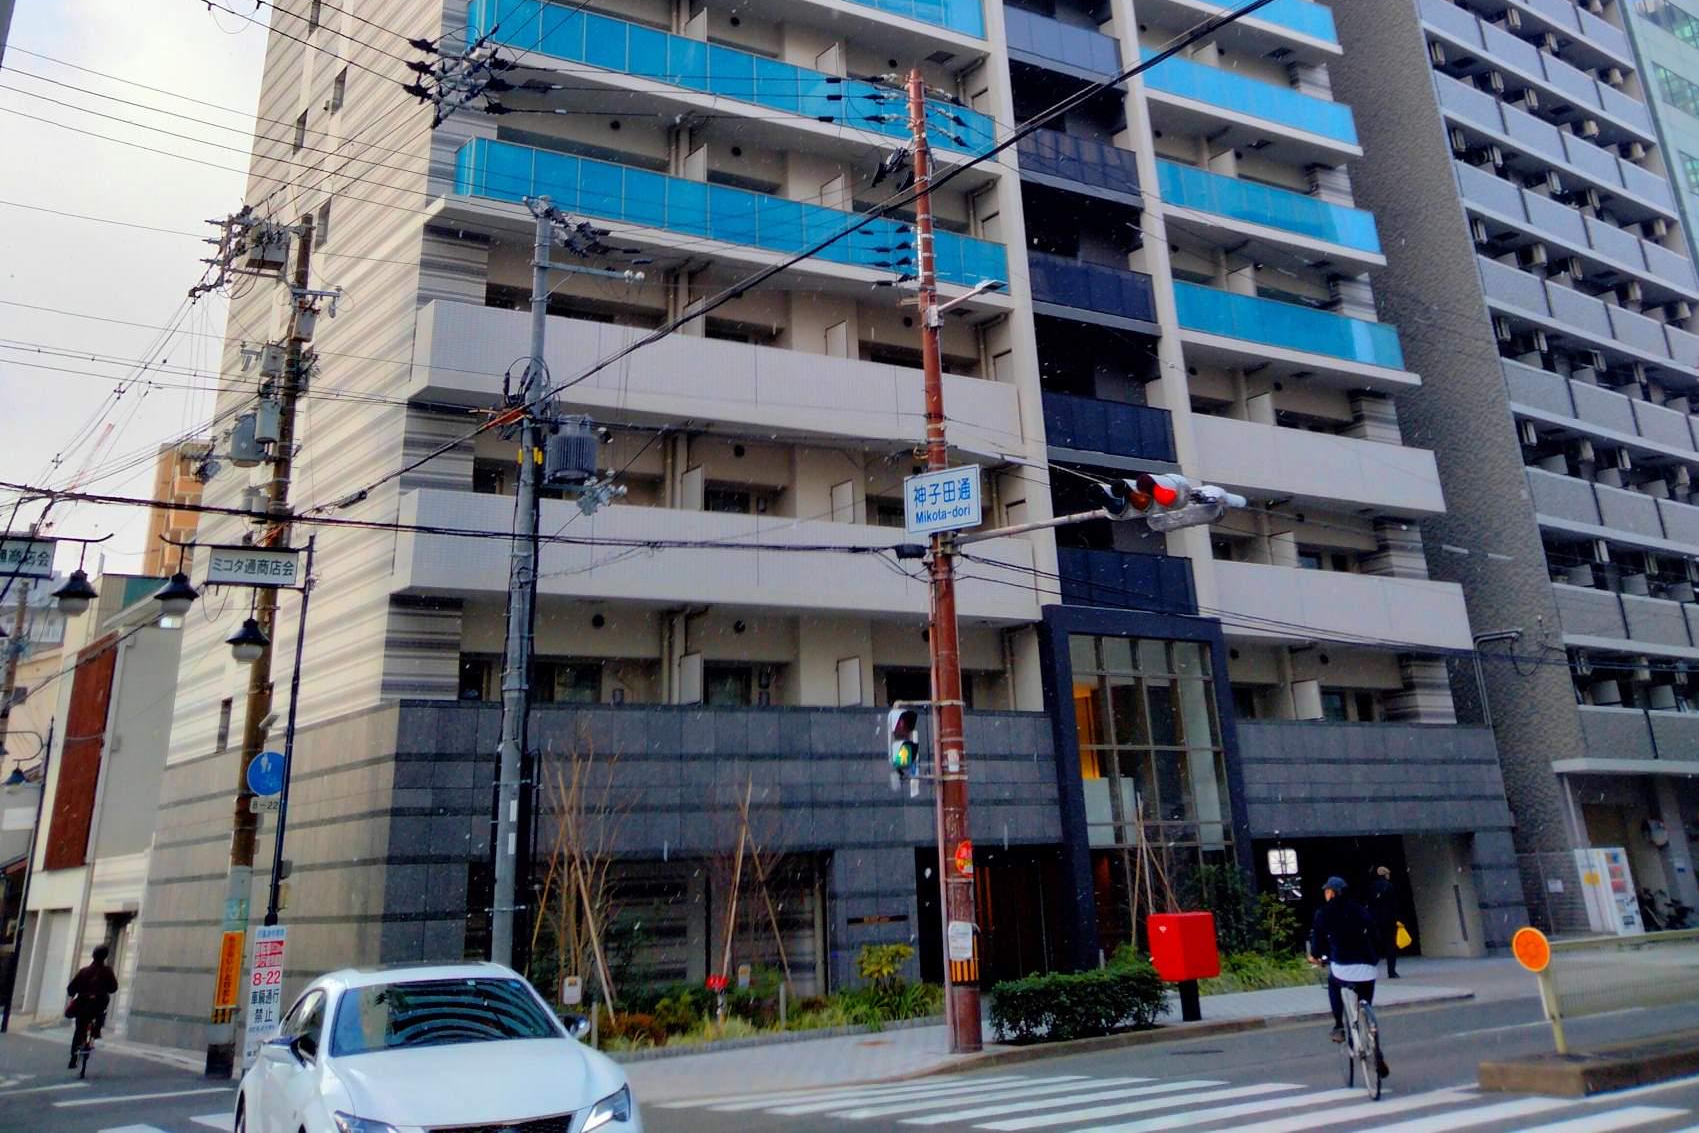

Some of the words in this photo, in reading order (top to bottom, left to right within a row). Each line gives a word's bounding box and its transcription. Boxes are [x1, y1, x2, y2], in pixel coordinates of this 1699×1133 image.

[914, 477, 971, 507] 神子田通
[915, 503, 971, 524] Mikota-dori
[213, 557, 295, 577] ミコタ通商店会
[252, 970, 281, 986] 8-22
[254, 1006, 274, 1024] 禁止
